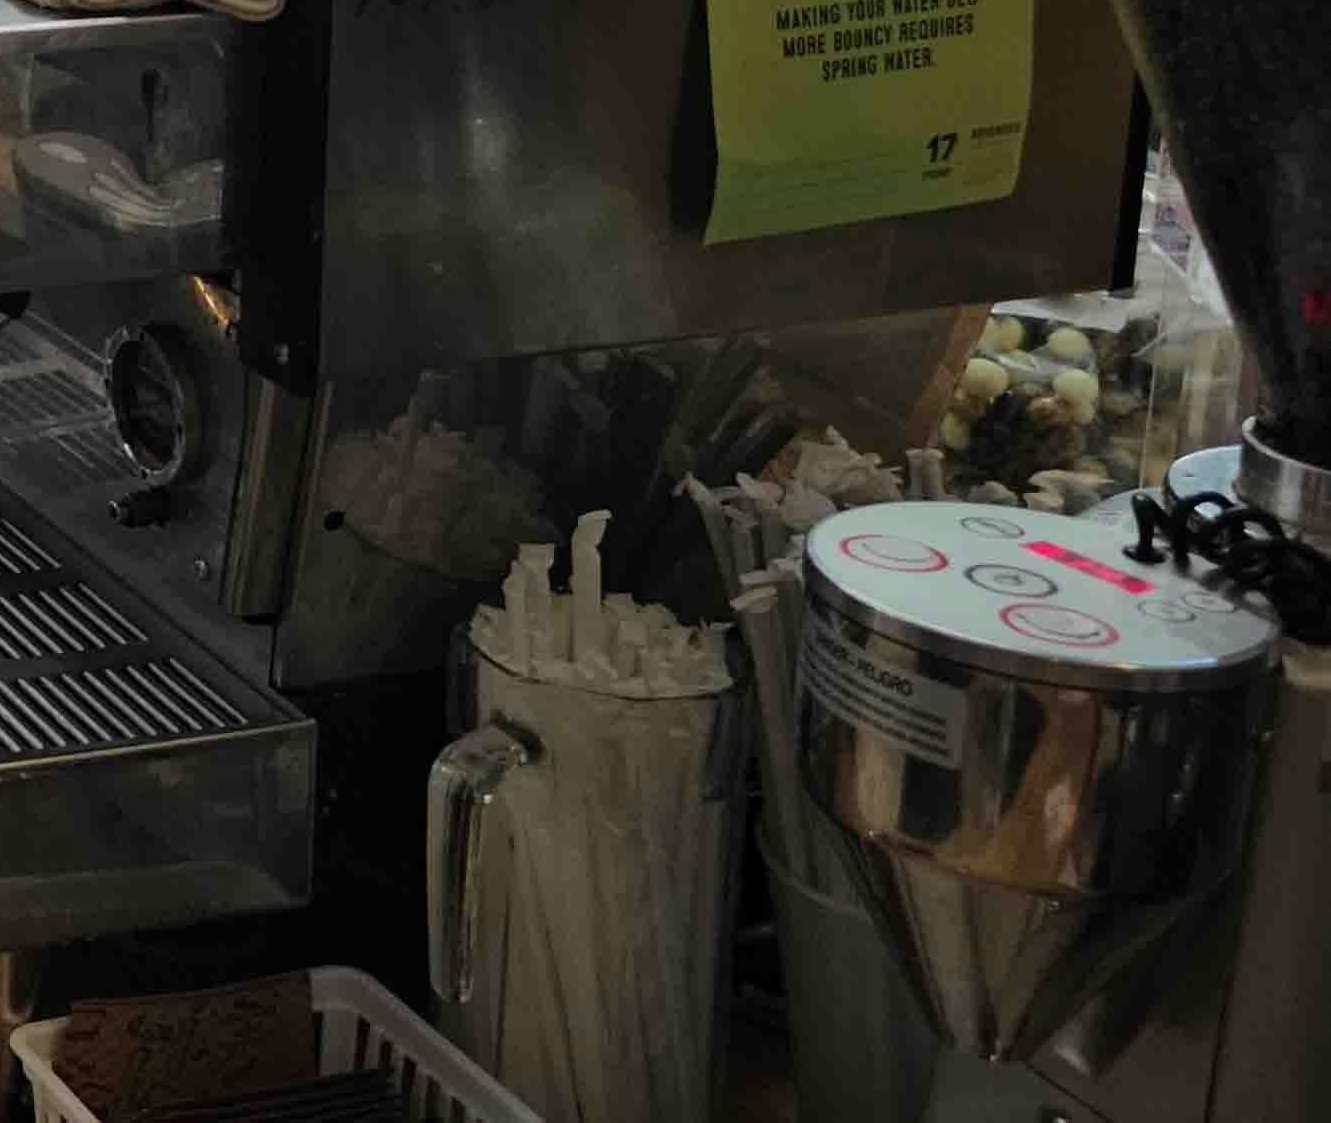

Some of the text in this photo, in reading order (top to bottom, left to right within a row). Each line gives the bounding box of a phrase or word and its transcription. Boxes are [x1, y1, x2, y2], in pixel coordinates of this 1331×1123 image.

[776, 4, 841, 29] MAKING
[782, 13, 974, 57] MORE BOUNCY REQUIRES
[823, 55, 877, 81] SPRING
[926, 132, 958, 163] 17
